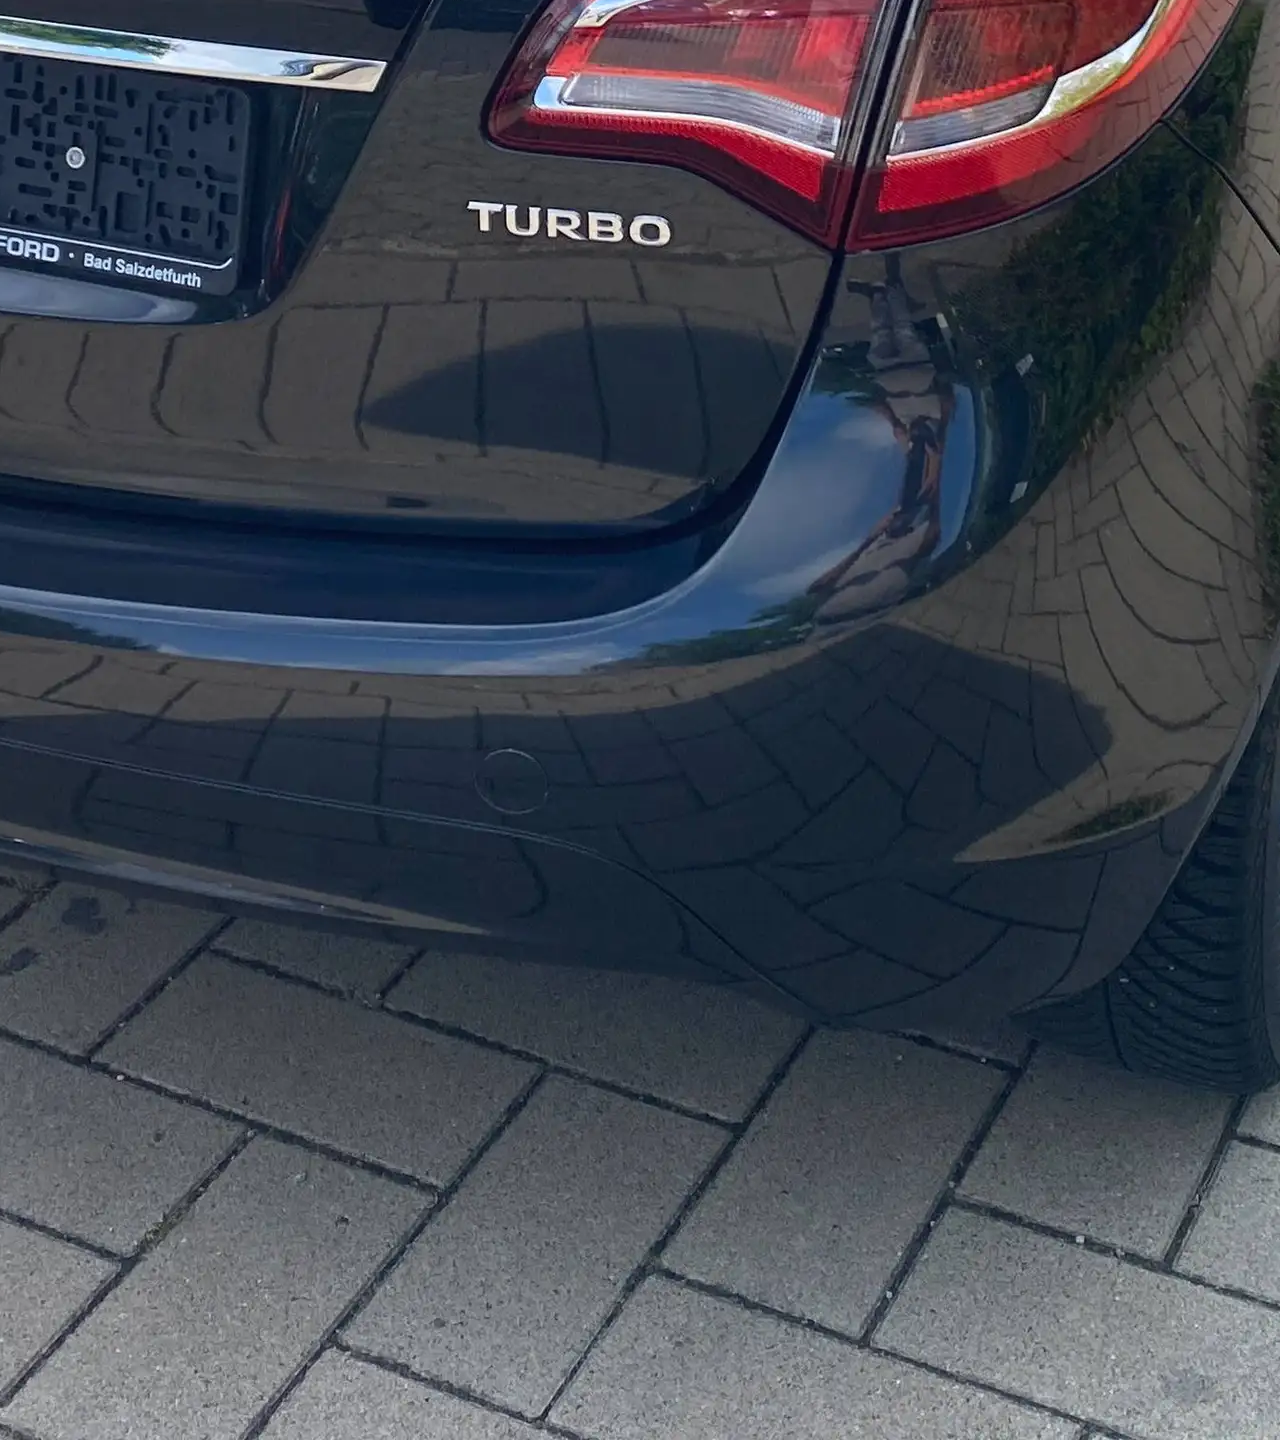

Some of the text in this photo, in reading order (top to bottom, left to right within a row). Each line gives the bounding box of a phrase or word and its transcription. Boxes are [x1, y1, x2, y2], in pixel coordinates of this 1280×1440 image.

[466, 200, 671, 248] TURBO
[83, 252, 112, 271] Bad
[115, 259, 202, 289] Salzdetfurth
